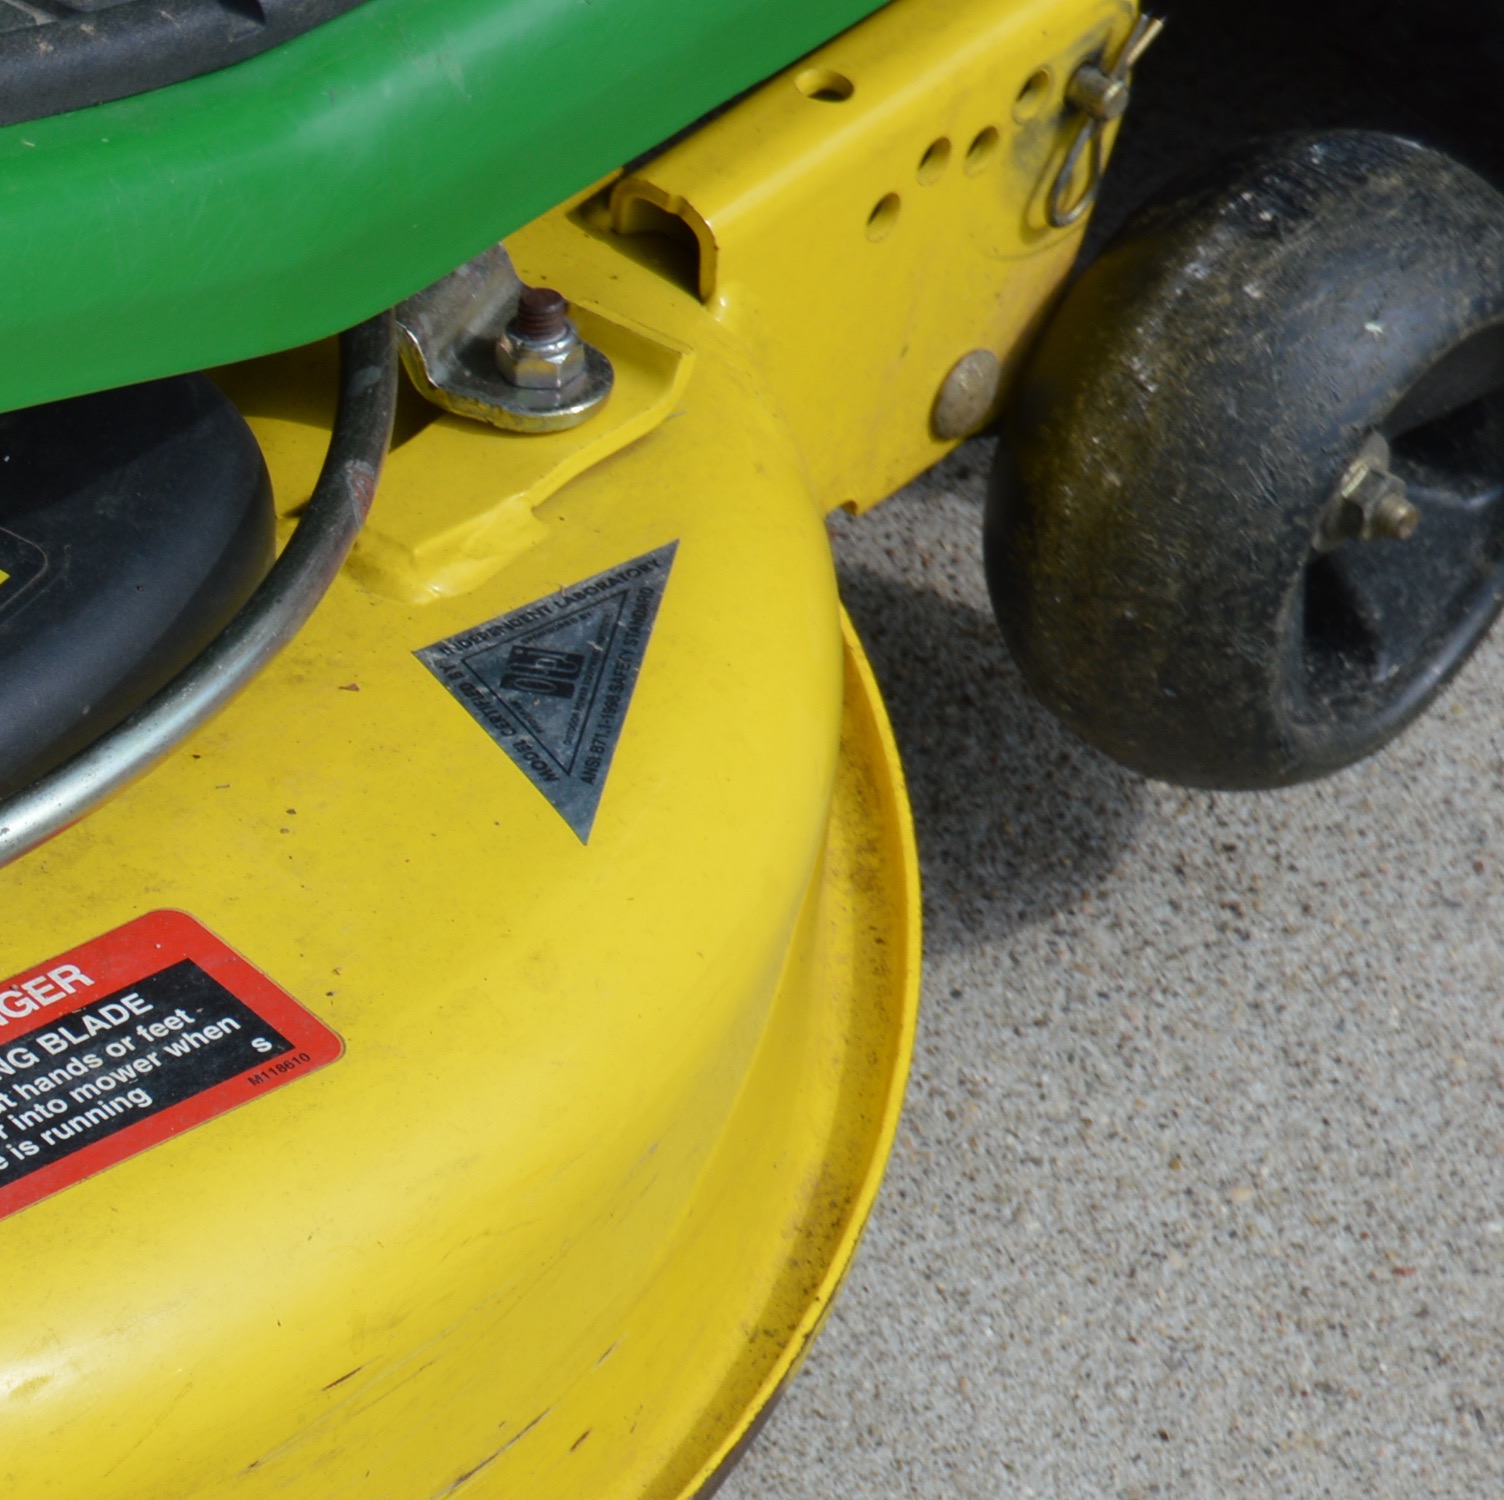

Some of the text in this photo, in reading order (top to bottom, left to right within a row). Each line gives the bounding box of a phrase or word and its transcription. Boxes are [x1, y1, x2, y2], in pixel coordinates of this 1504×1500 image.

[554, 559, 661, 612] LABORATORY
[580, 756, 602, 785] ANSI
[624, 586, 655, 648] STANDARD
[12, 1053, 103, 1100] hands
[106, 1035, 136, 1058] or
[136, 1008, 195, 1042] feet
[36, 992, 154, 1056] BLADE
[7, 1098, 68, 1131] into
[69, 1051, 162, 1103] mower
[163, 1016, 241, 1058] when
[6, 1140, 40, 1160] is
[40, 1086, 153, 1146] running
